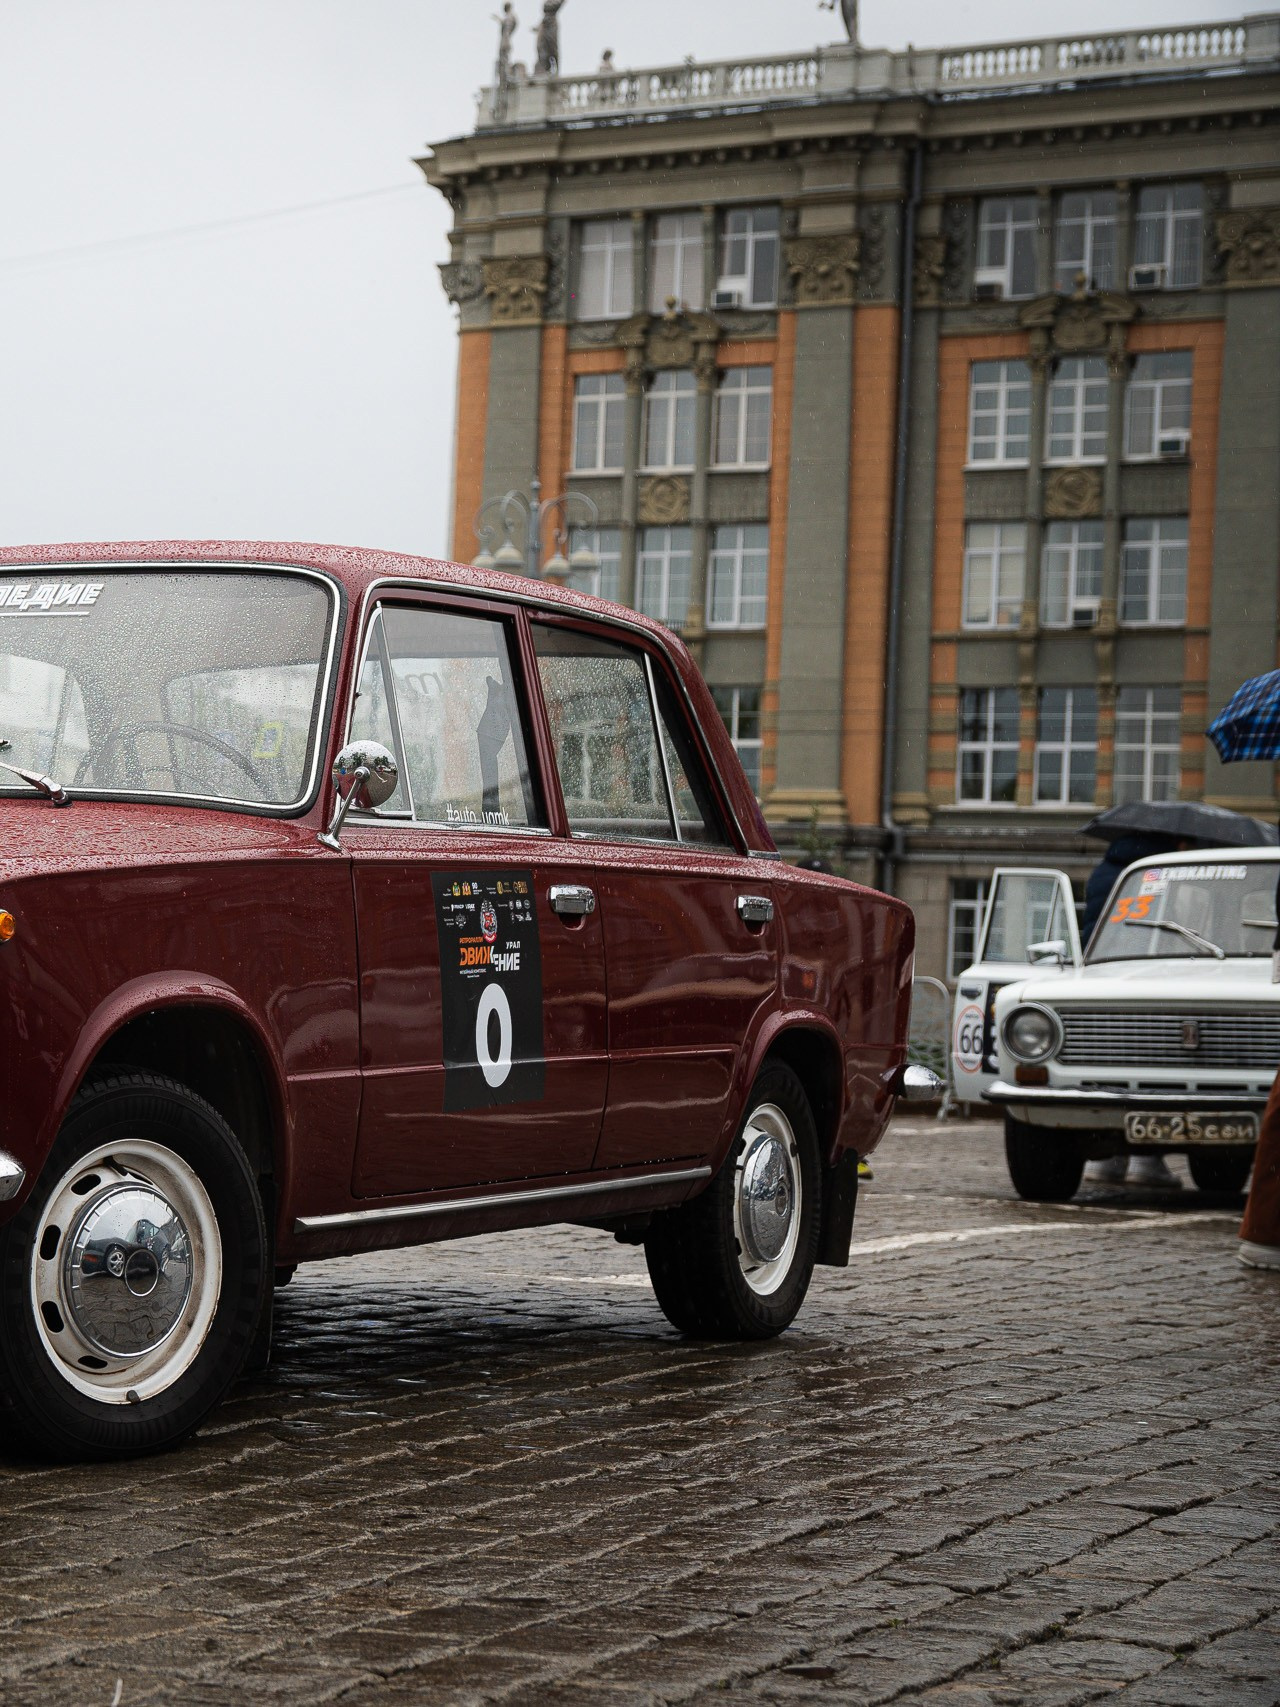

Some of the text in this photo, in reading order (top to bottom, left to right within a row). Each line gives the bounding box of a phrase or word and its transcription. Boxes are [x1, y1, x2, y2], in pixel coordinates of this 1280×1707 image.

[1109, 895, 1155, 924] 33
[505, 940, 521, 950] УРАЛ
[475, 982, 513, 1088] 0
[960, 1023, 984, 1054] 66
